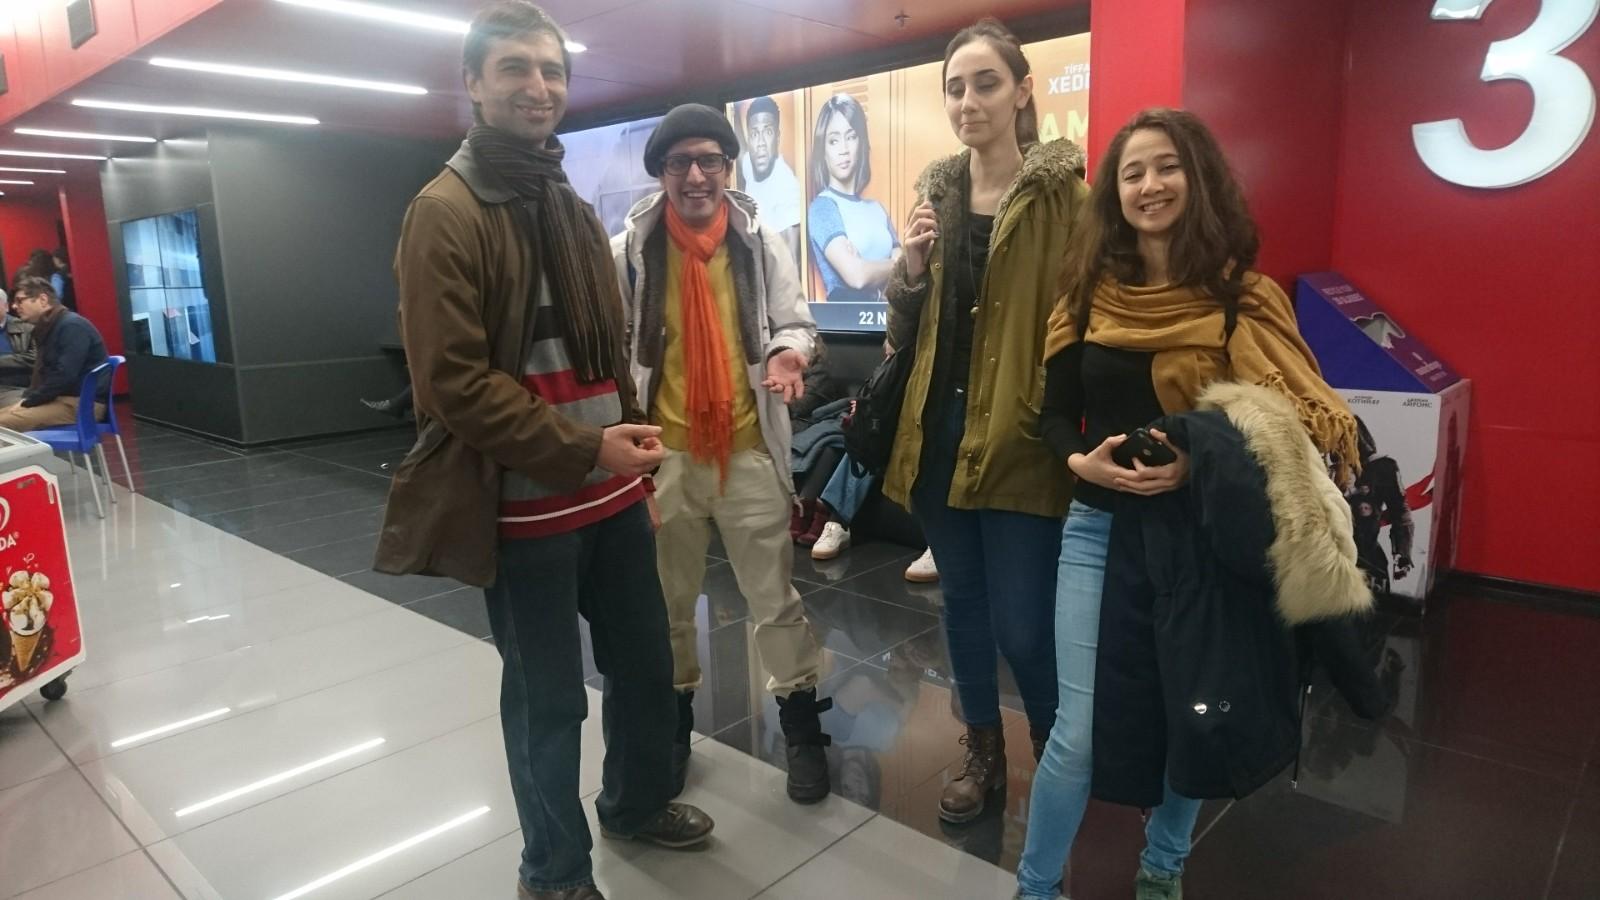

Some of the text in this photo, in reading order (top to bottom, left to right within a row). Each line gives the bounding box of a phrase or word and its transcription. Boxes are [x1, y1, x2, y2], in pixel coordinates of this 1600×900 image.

[1411, 0, 1599, 189] 3
[859, 311, 887, 325] 22 N
